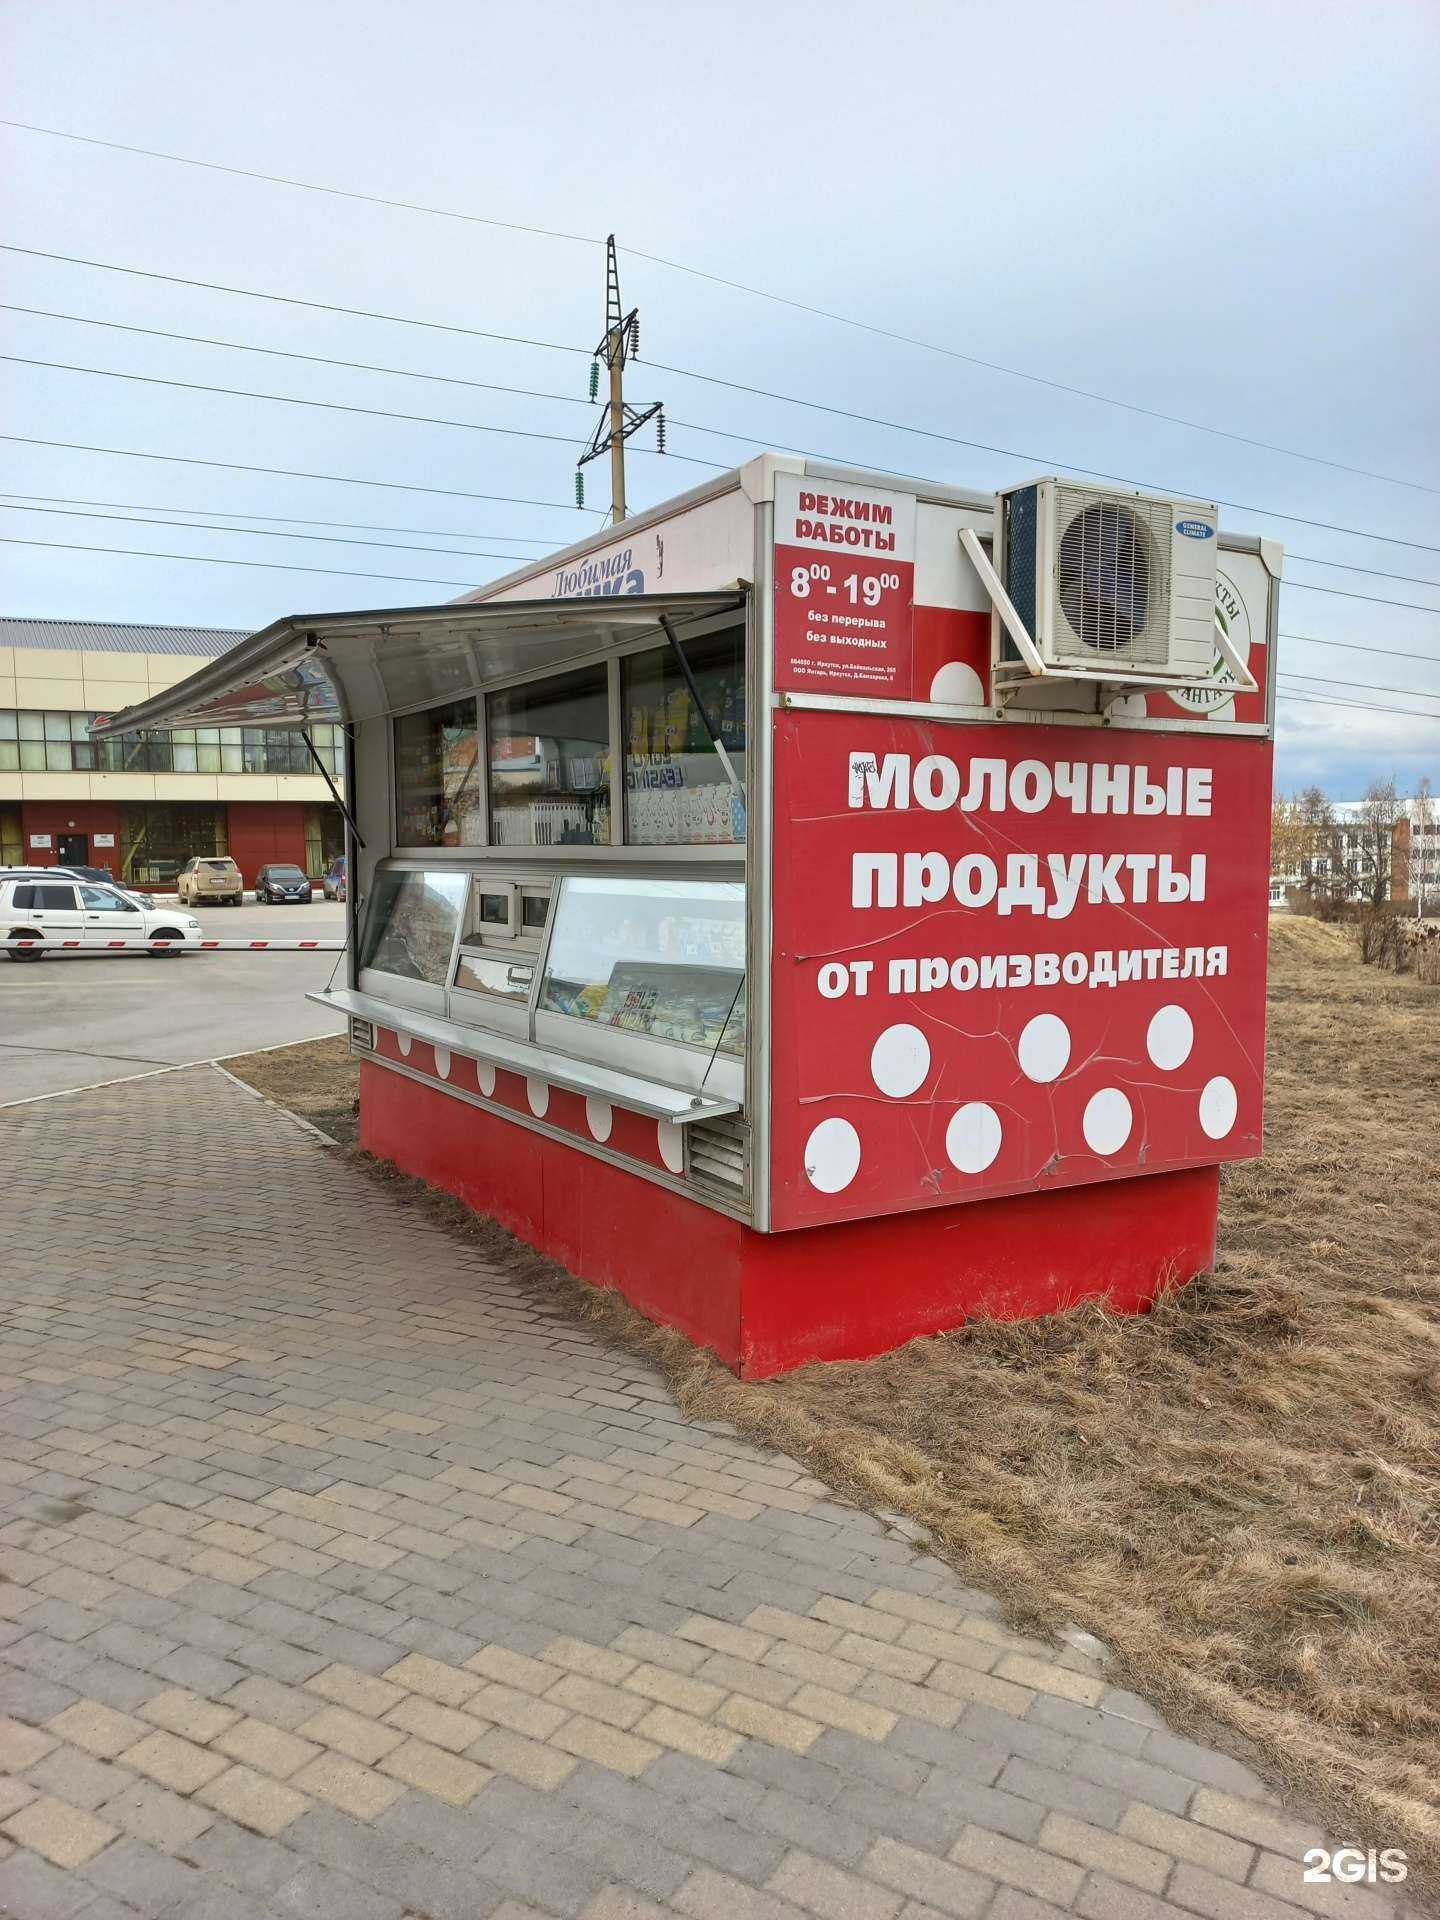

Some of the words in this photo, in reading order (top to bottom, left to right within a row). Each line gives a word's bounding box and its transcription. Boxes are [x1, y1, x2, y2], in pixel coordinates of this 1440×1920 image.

[799, 491, 893, 525] РЕЖИМ
[795, 518, 895, 551] РАБОТЫ
[1182, 522, 1207, 532] GENERAL
[1183, 529, 1207, 538] CLIMATE
[551, 548, 633, 598] Любимая
[807, 610, 829, 623] без
[831, 615, 886, 630] перерыва
[806, 630, 829, 643] без
[830, 635, 888, 650] выходных
[848, 751, 1213, 816] МОЛОЧНЫЕ
[851, 851, 1207, 920] ПРОДУКТЫ
[816, 960, 874, 999] ОТ
[888, 946, 1228, 994] ПРОИЗВОДИТЕЛЯ
